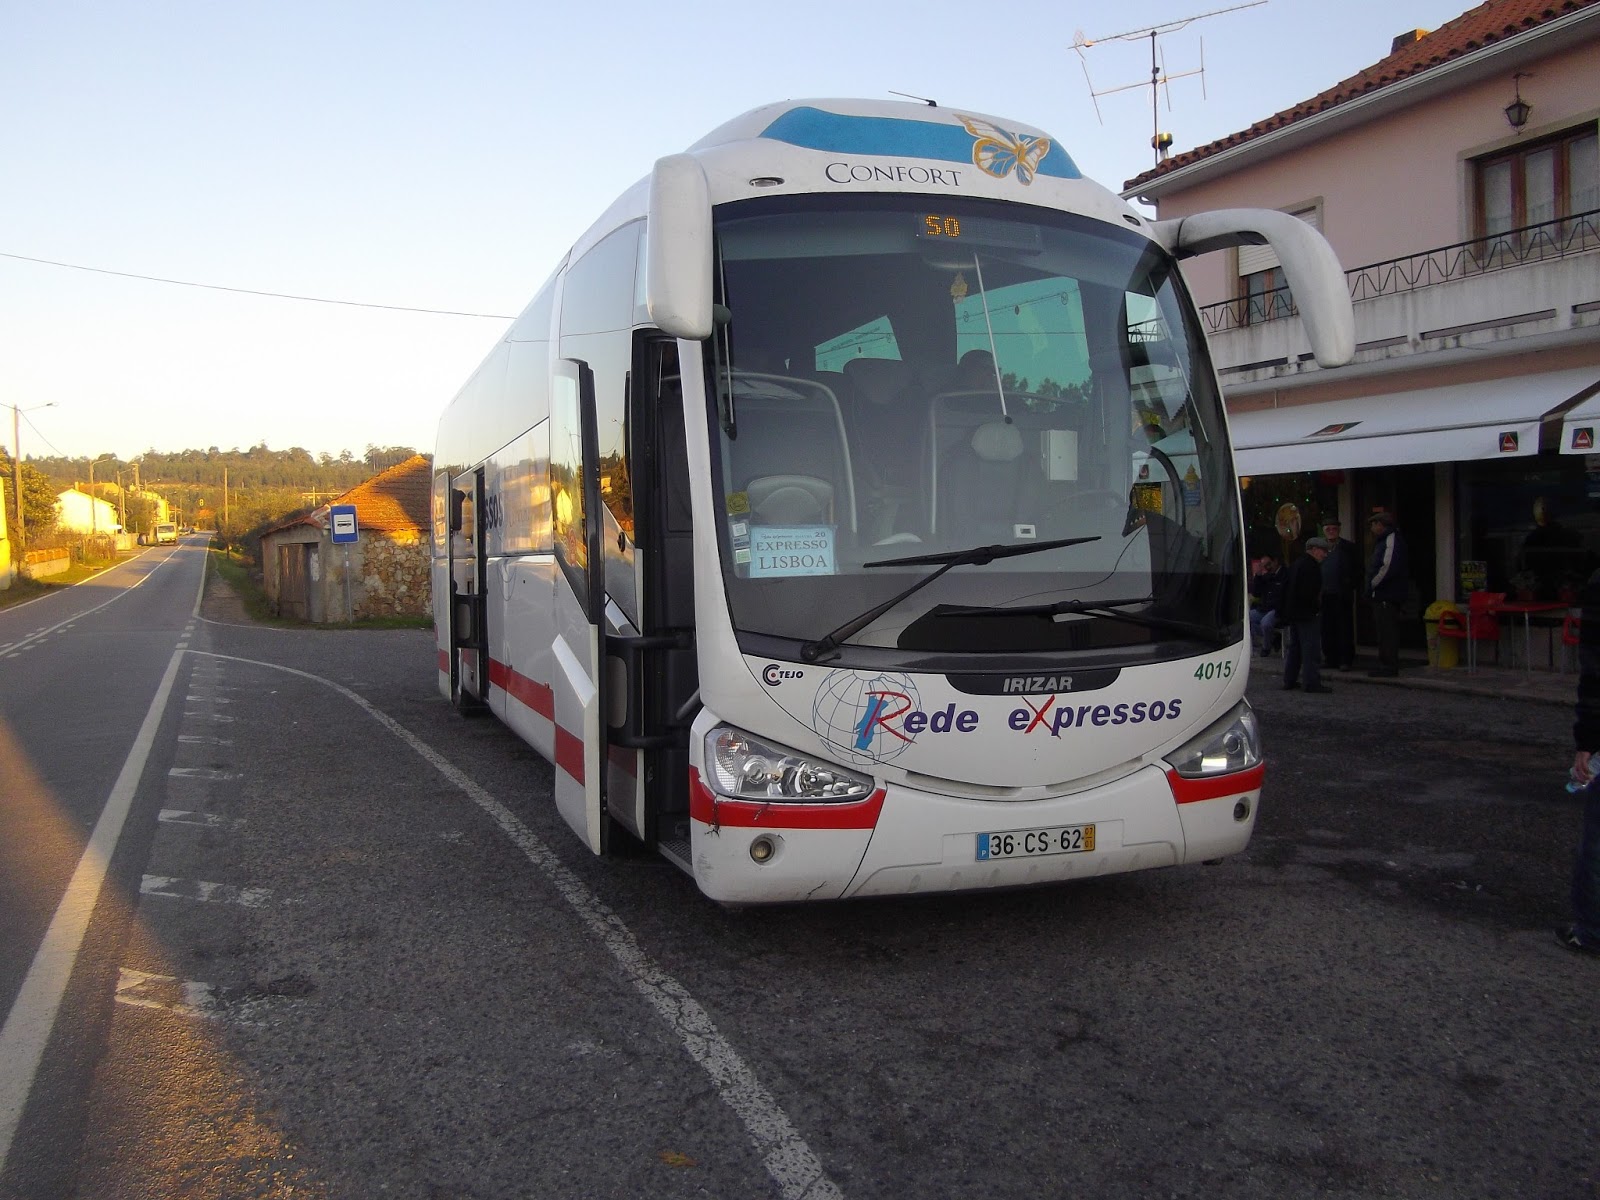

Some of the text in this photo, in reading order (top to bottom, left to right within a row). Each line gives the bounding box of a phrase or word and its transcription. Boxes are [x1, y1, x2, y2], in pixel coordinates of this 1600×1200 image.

[756, 540, 828, 551] EXPRESSO
[759, 555, 828, 570] LISBOA
[1193, 661, 1232, 680] 4015
[1003, 676, 1074, 693] IRIZAR
